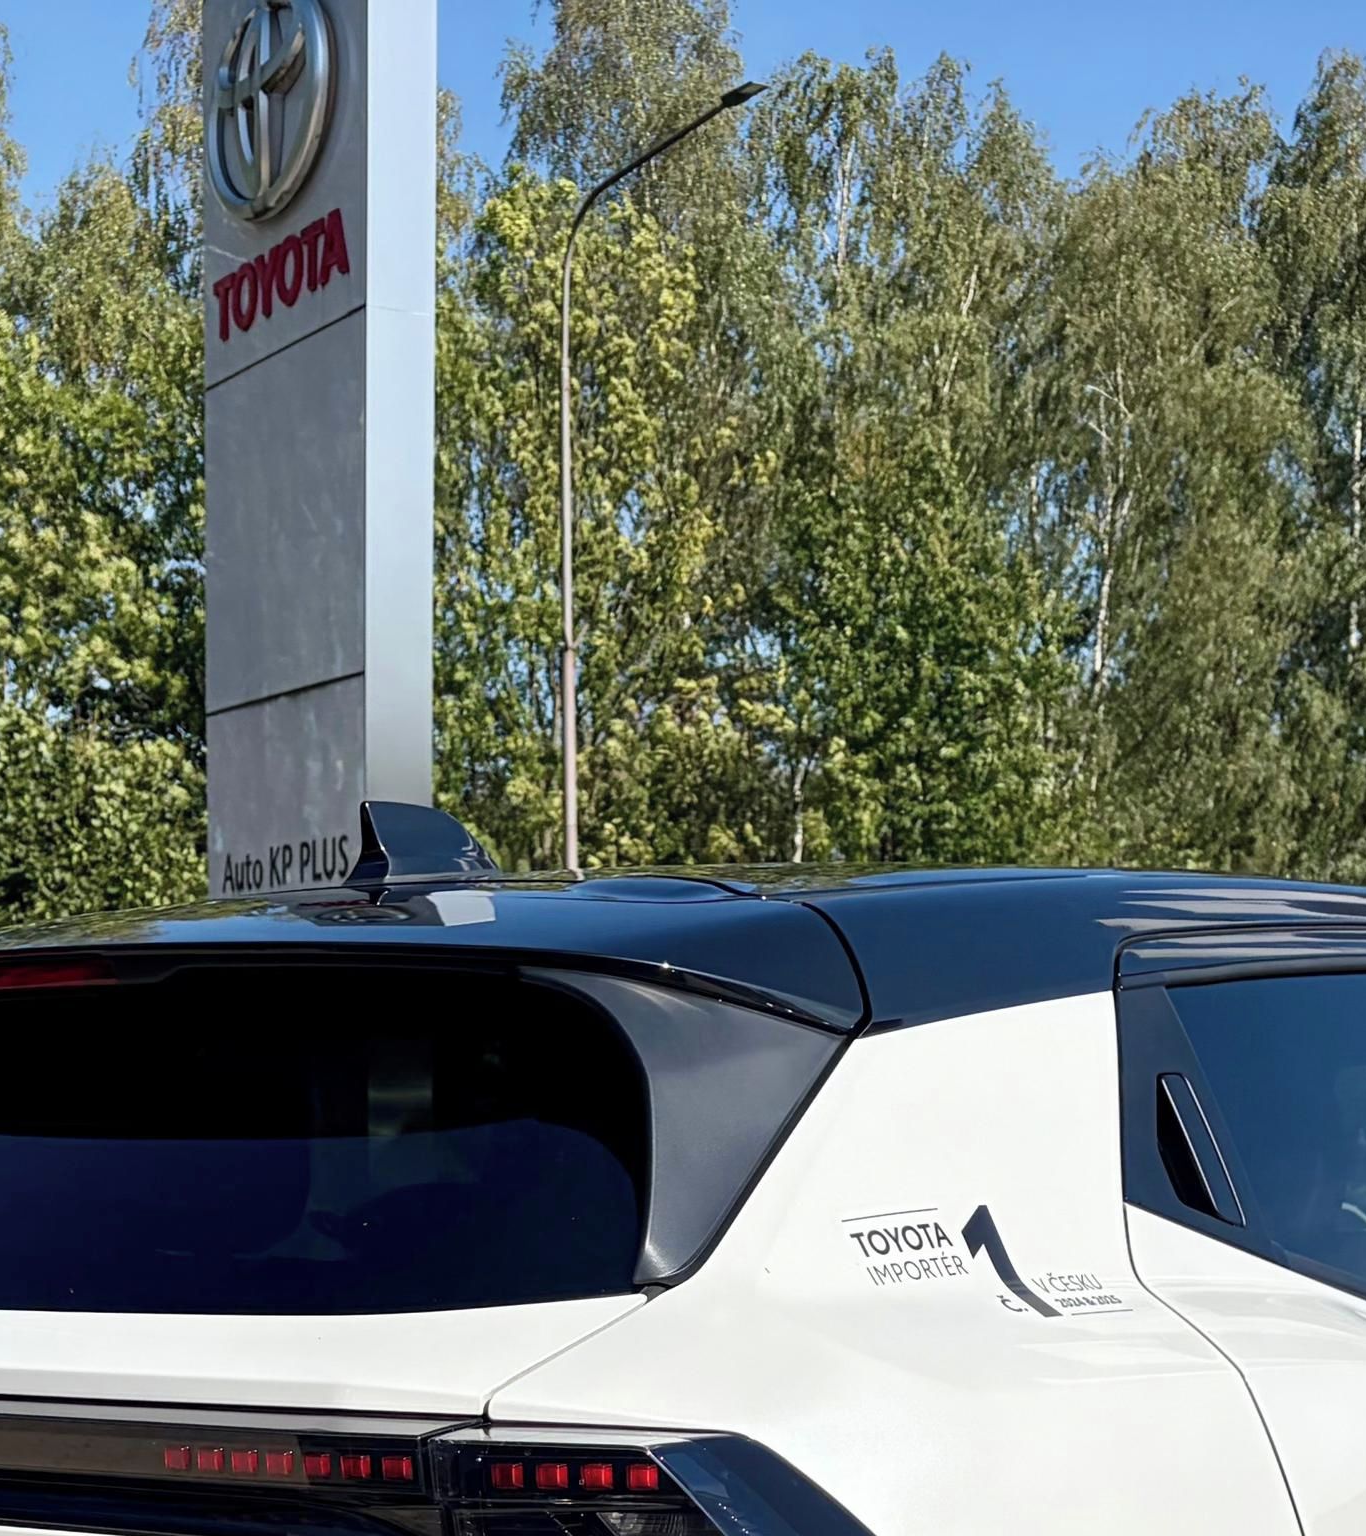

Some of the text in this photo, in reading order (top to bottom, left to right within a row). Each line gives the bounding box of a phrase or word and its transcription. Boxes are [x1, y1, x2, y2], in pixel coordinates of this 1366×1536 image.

[213, 208, 350, 342] TOYOTA
[222, 835, 349, 894] Auto KP PLUS
[850, 1222, 953, 1257] TOYOTA
[867, 1251, 969, 1286] IMPORTÉR
[1047, 1273, 1103, 1293] ČESKU
